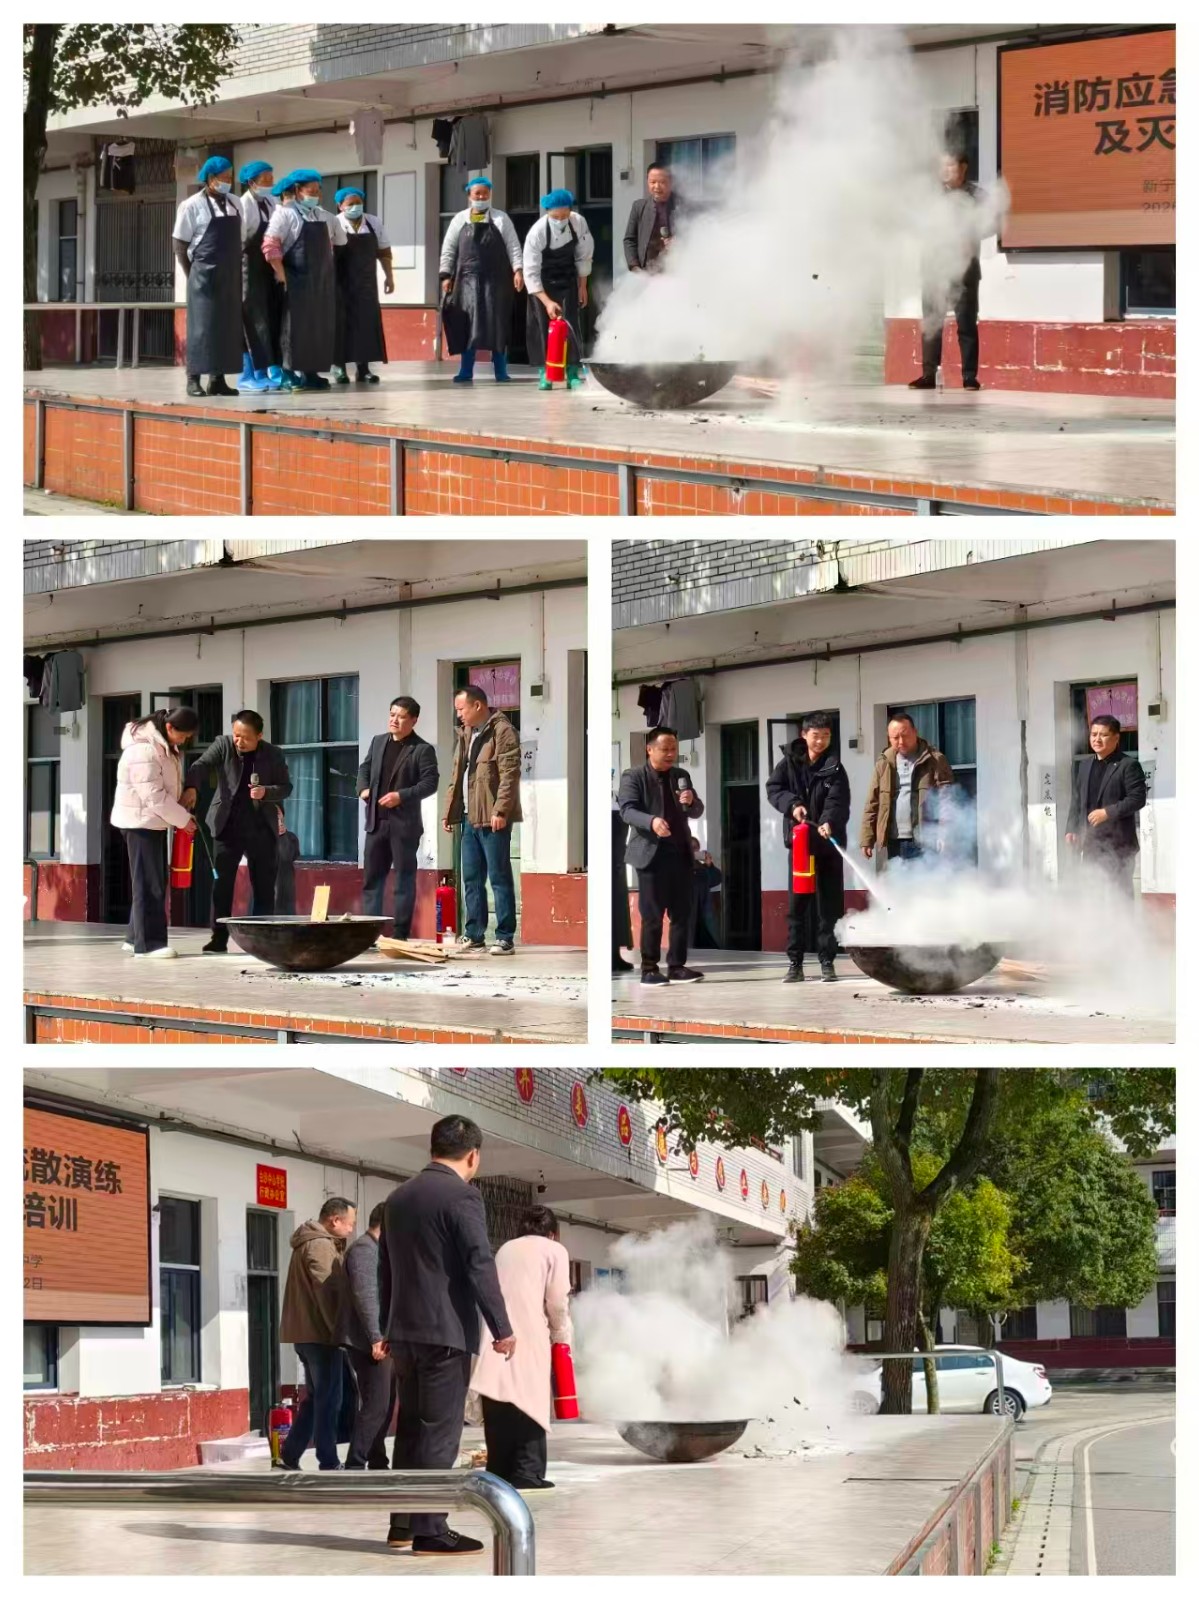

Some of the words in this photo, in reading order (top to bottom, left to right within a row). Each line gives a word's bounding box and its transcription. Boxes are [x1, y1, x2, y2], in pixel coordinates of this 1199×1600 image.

[1093, 114, 1175, 156] 及灭
[23, 1146, 123, 1195] 散演练
[23, 1191, 78, 1232] 培训
[23, 1276, 43, 1290] 2日
